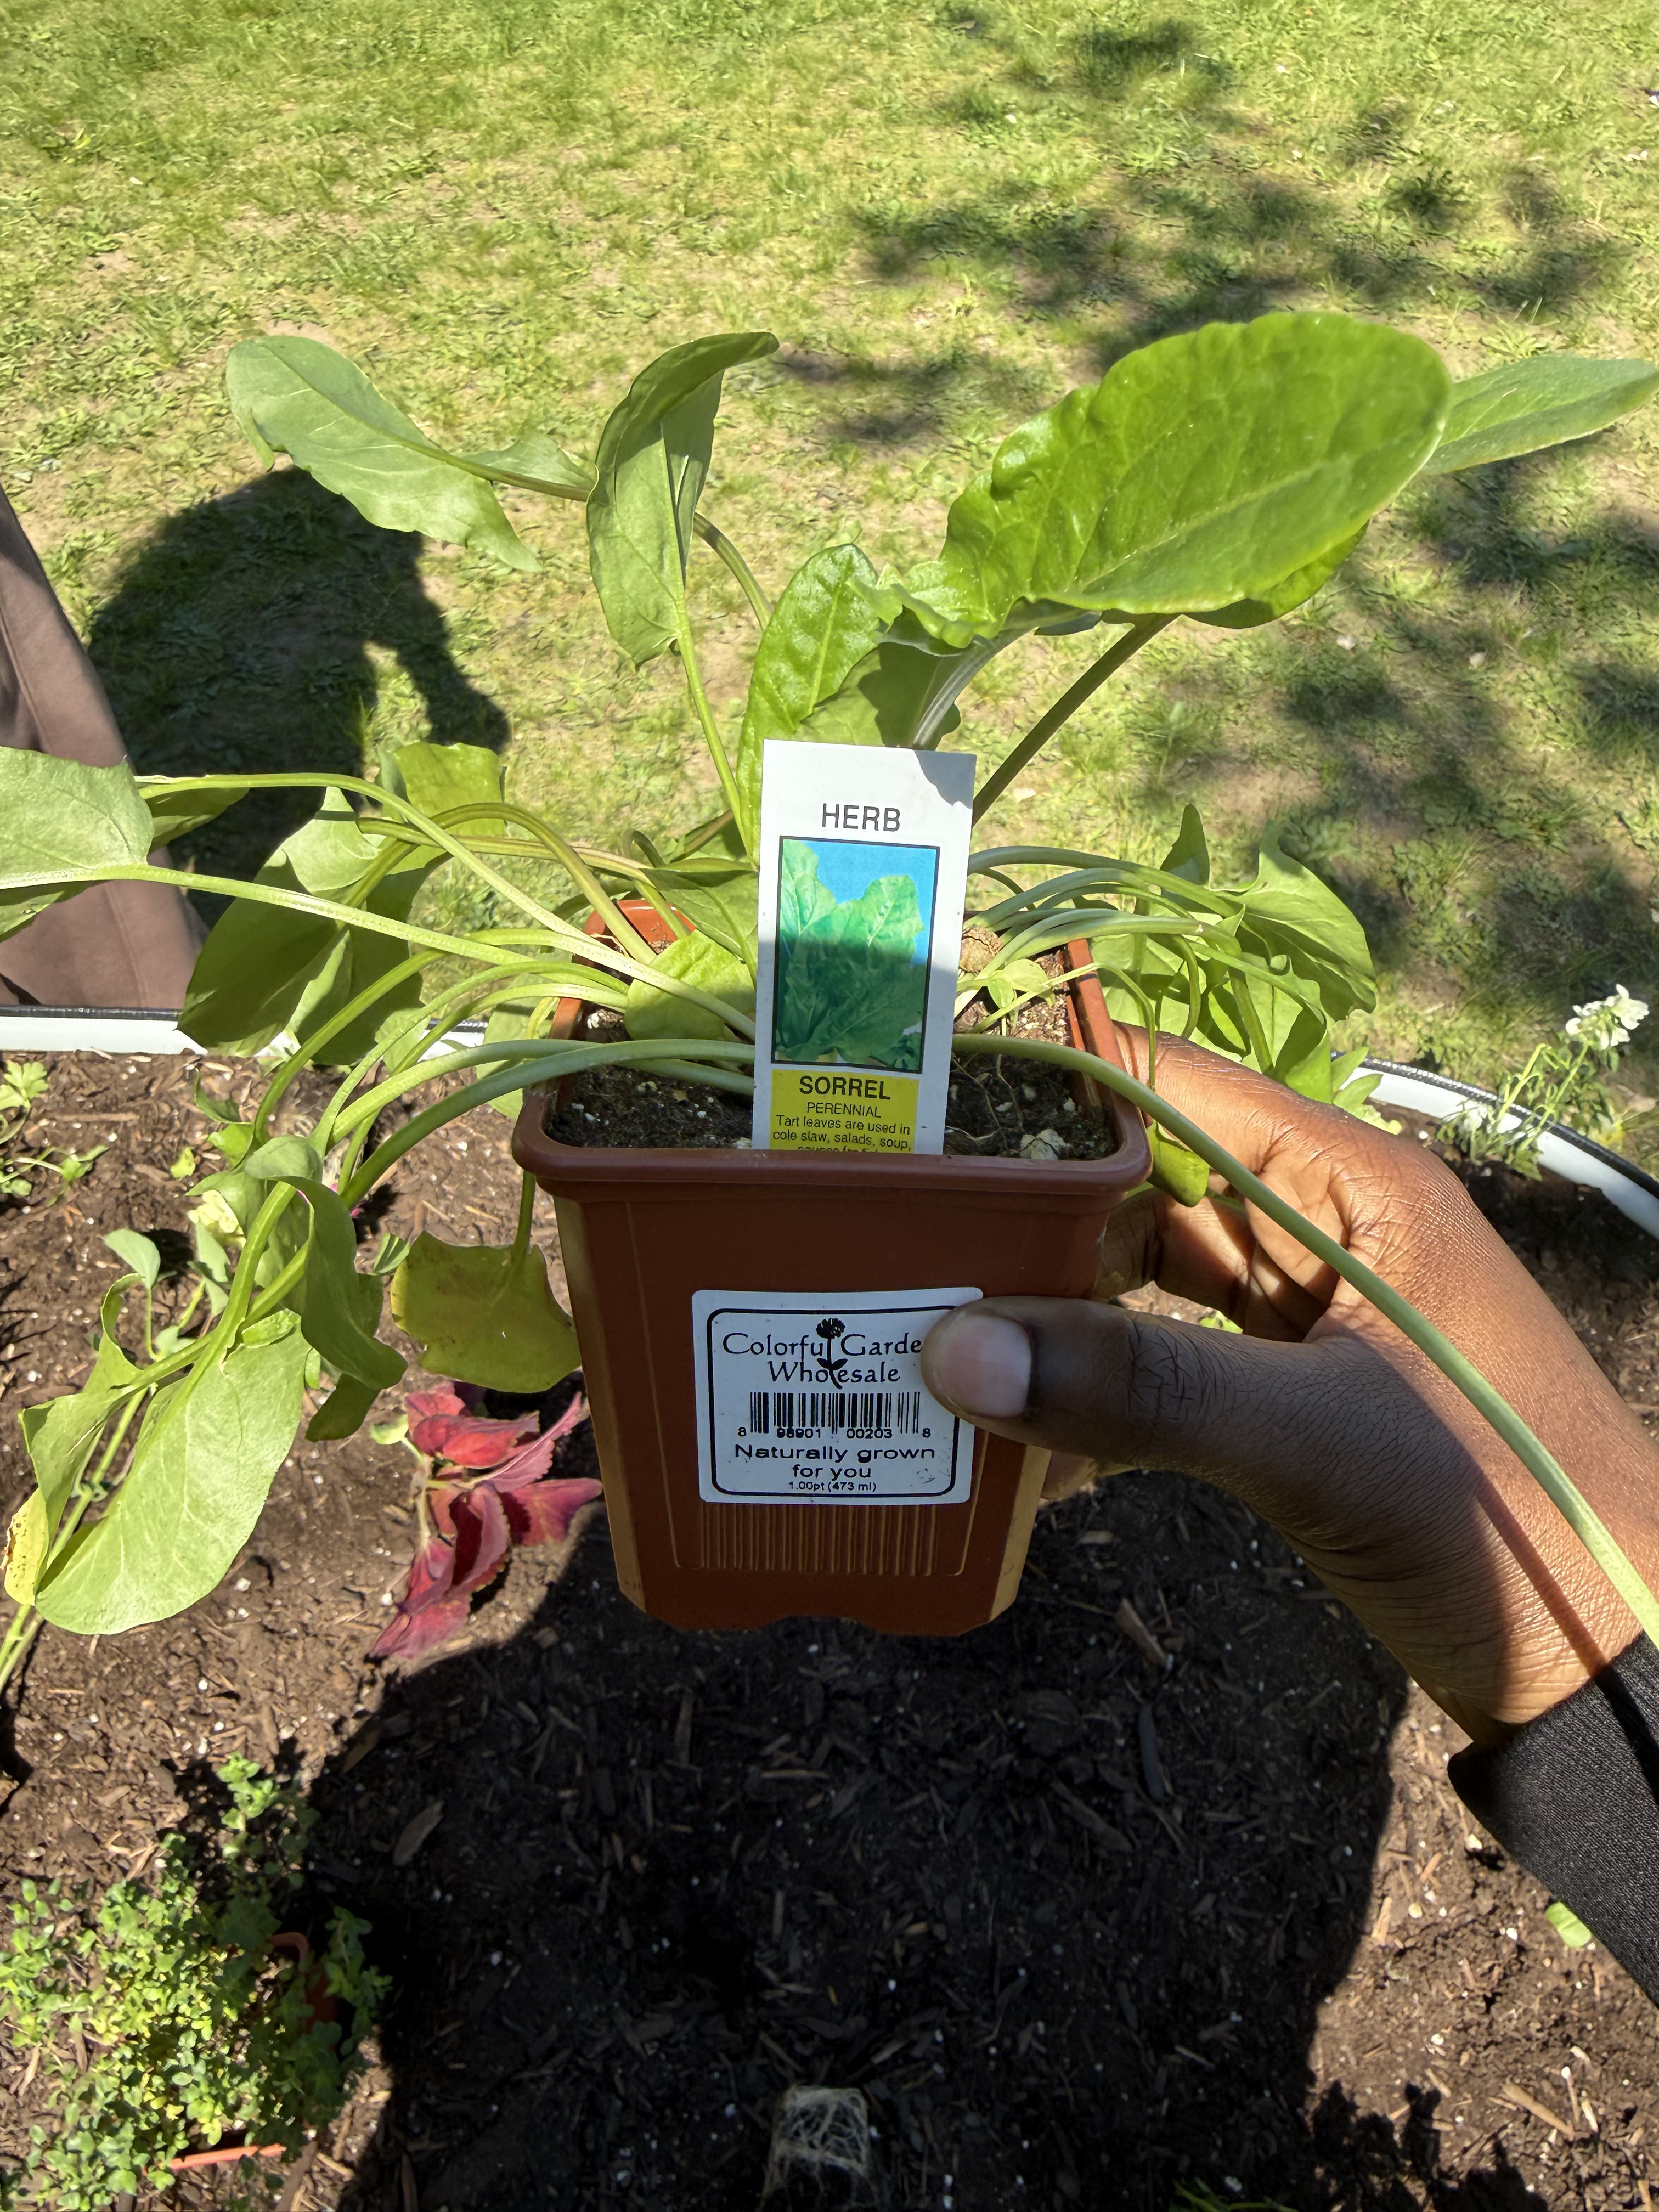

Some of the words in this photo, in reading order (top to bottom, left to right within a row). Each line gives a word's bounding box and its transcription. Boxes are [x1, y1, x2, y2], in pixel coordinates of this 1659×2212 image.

[822, 803, 900, 832] HERB
[799, 1075, 891, 1101] SORREL
[806, 1102, 882, 1118] PERENNIAL
[776, 1114, 799, 1127] Tart
[803, 1116, 841, 1128] leaves
[845, 1121, 864, 1130] are
[867, 1122, 896, 1134] used
[899, 1123, 910, 1135] in
[772, 1129, 797, 1141] cole
[801, 1130, 831, 1144] slaw,
[834, 1133, 876, 1147] salads,
[879, 1138, 911, 1151] soup,
[840, 1332, 923, 1357] Garde
[766, 1360, 901, 1384] Wholesale
[737, 1426, 747, 1437] 8
[845, 1427, 893, 1440] 00203
[922, 1427, 932, 1438] 8
[735, 1444, 848, 1463] Naturally
[857, 1448, 935, 1464] grown
[792, 1464, 824, 1478] for
[830, 1467, 872, 1481] you
[788, 1481, 825, 1492] 1.00pt
[827, 1481, 855, 1492] (473
[857, 1481, 877, 1493] ml)
